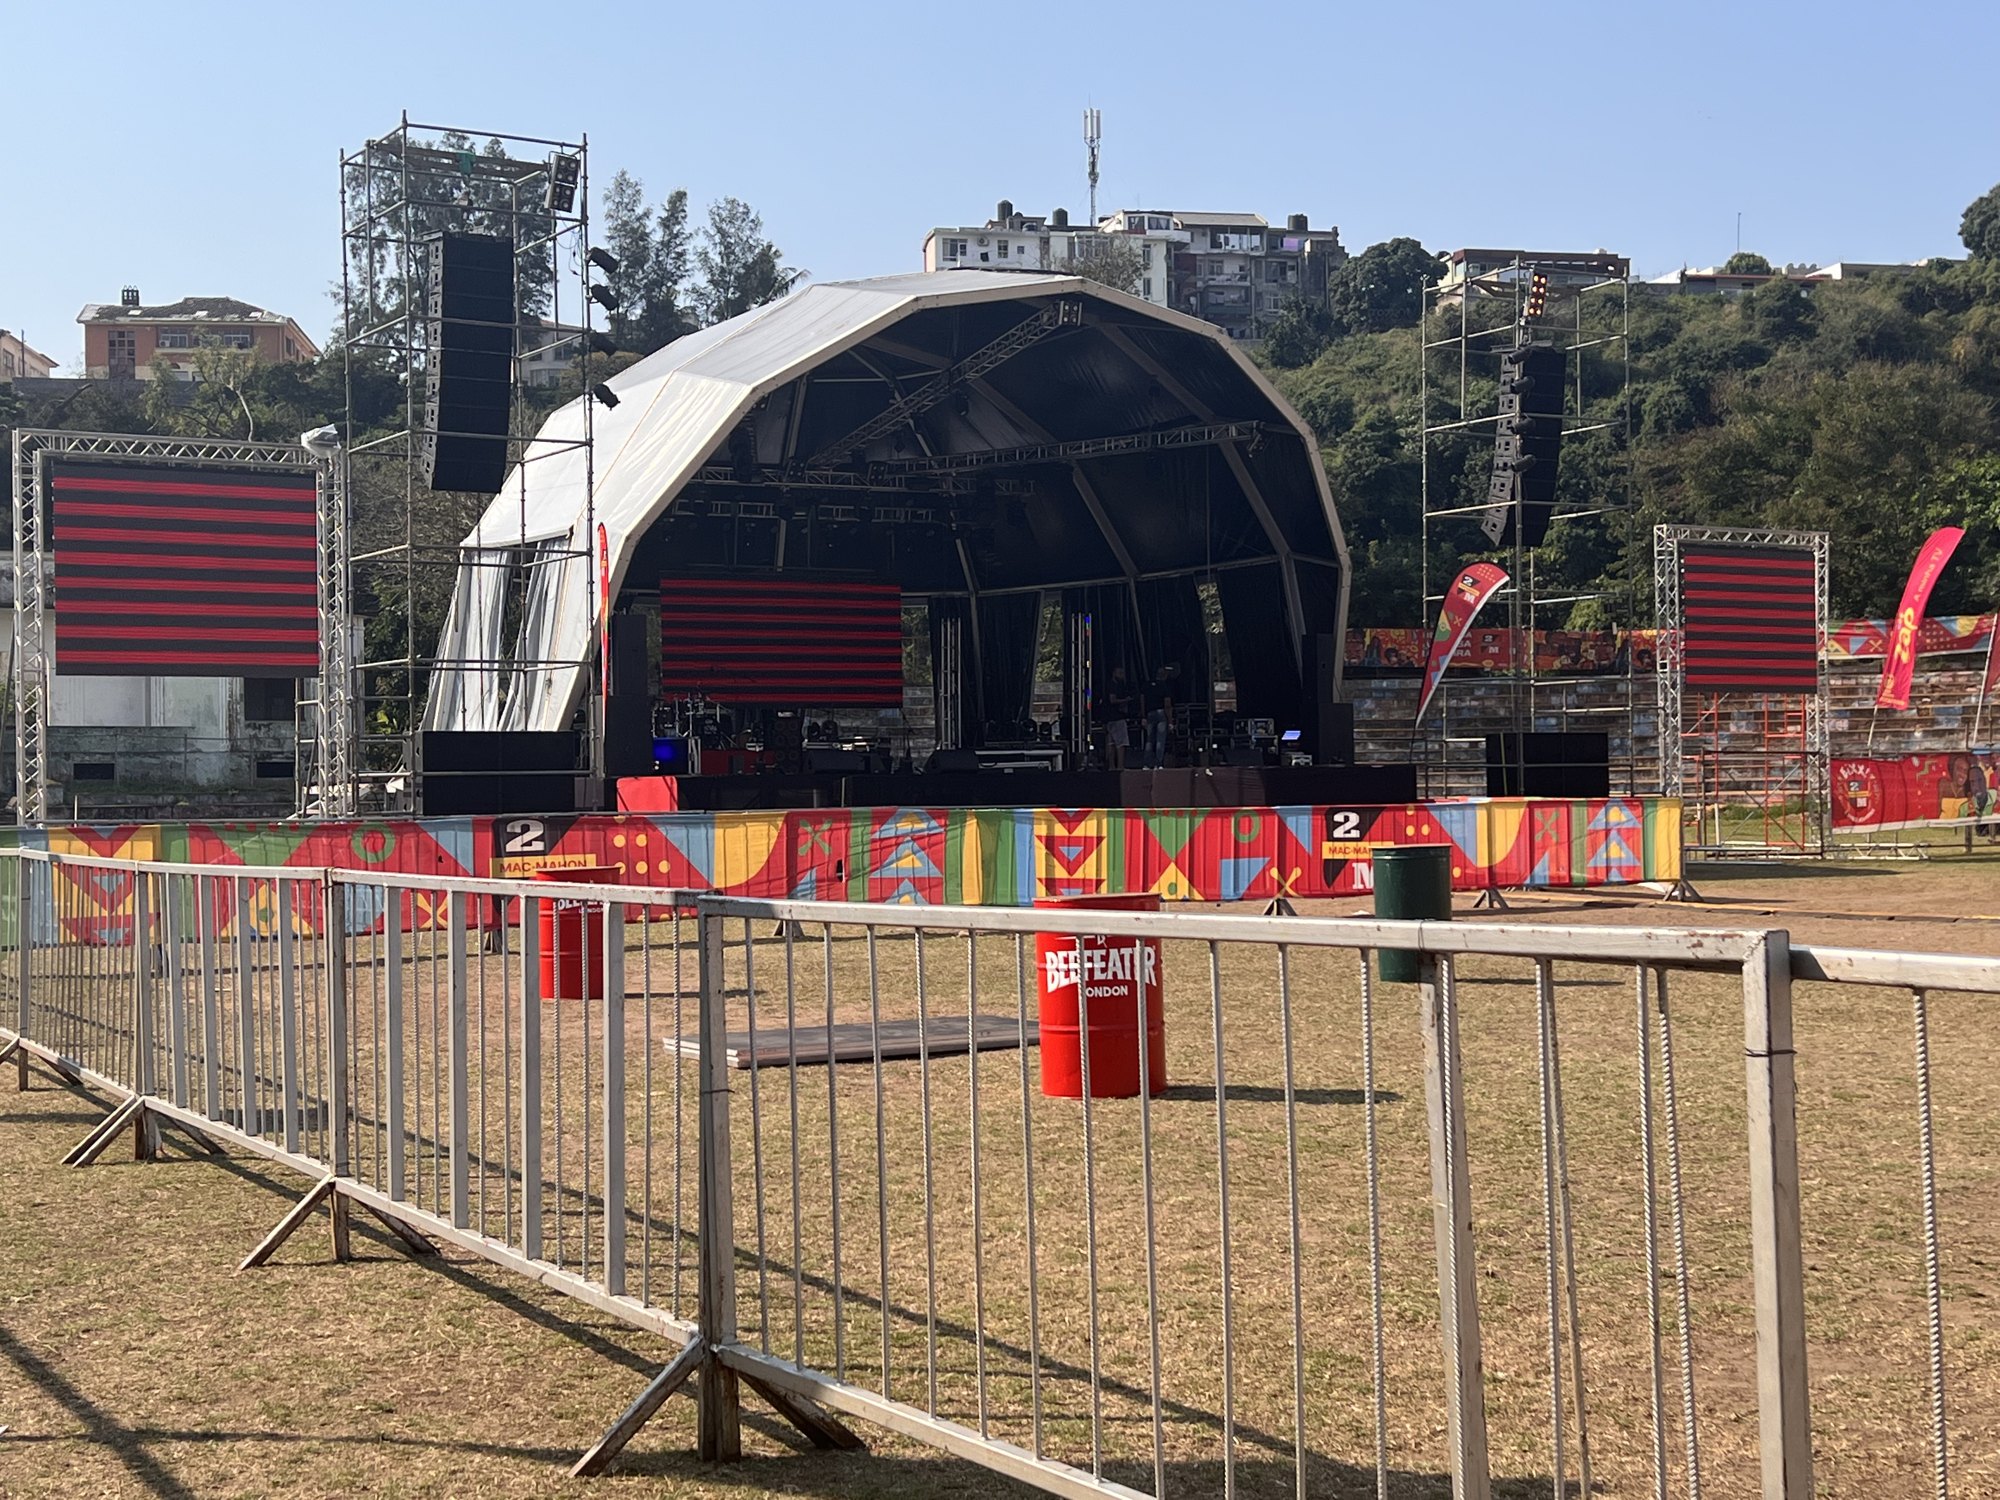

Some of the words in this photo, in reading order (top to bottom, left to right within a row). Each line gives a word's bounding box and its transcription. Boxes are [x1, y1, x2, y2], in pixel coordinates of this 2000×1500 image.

[1463, 576, 1473, 587] 2
[1333, 812, 1360, 838] 2
[506, 820, 545, 852] 2
[1084, 985, 1129, 998] ONDON
